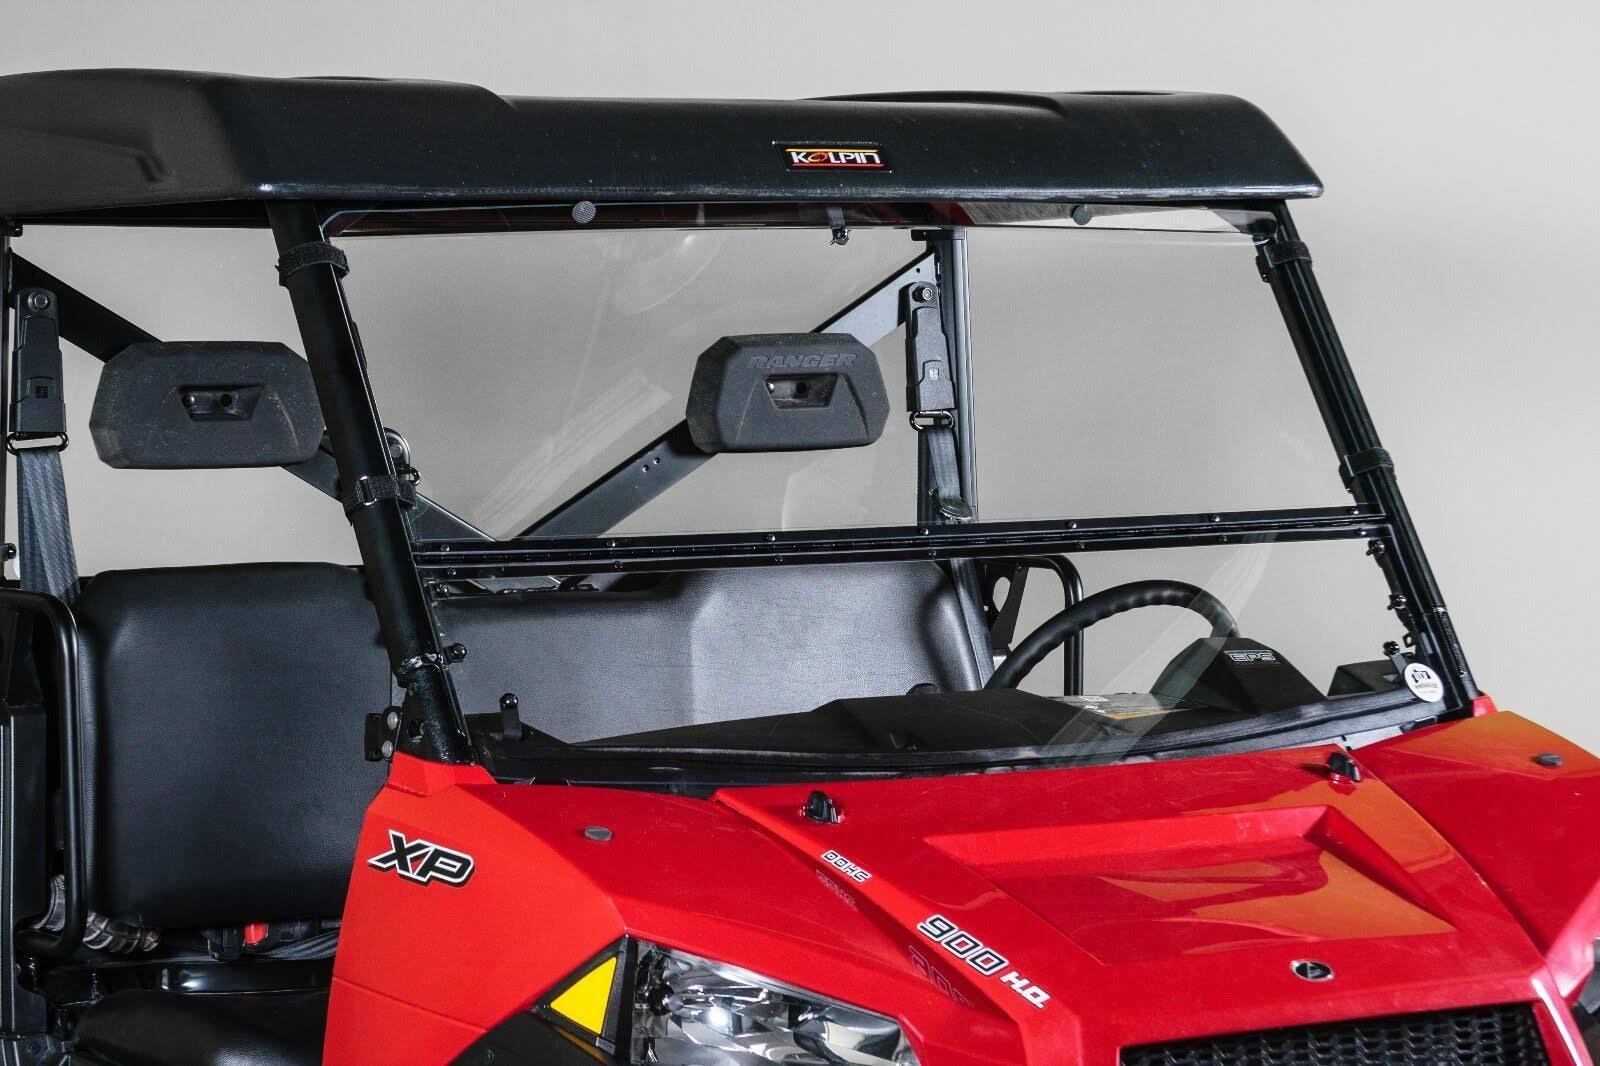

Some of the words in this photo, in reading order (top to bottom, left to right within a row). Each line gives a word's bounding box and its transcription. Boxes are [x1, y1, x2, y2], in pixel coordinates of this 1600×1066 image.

[790, 151, 881, 164] KOLPIN
[748, 353, 858, 368] RANGER
[1228, 651, 1276, 662] EPS
[366, 829, 474, 885] XP
[820, 849, 873, 883] DOHC
[916, 914, 1010, 976] 900
